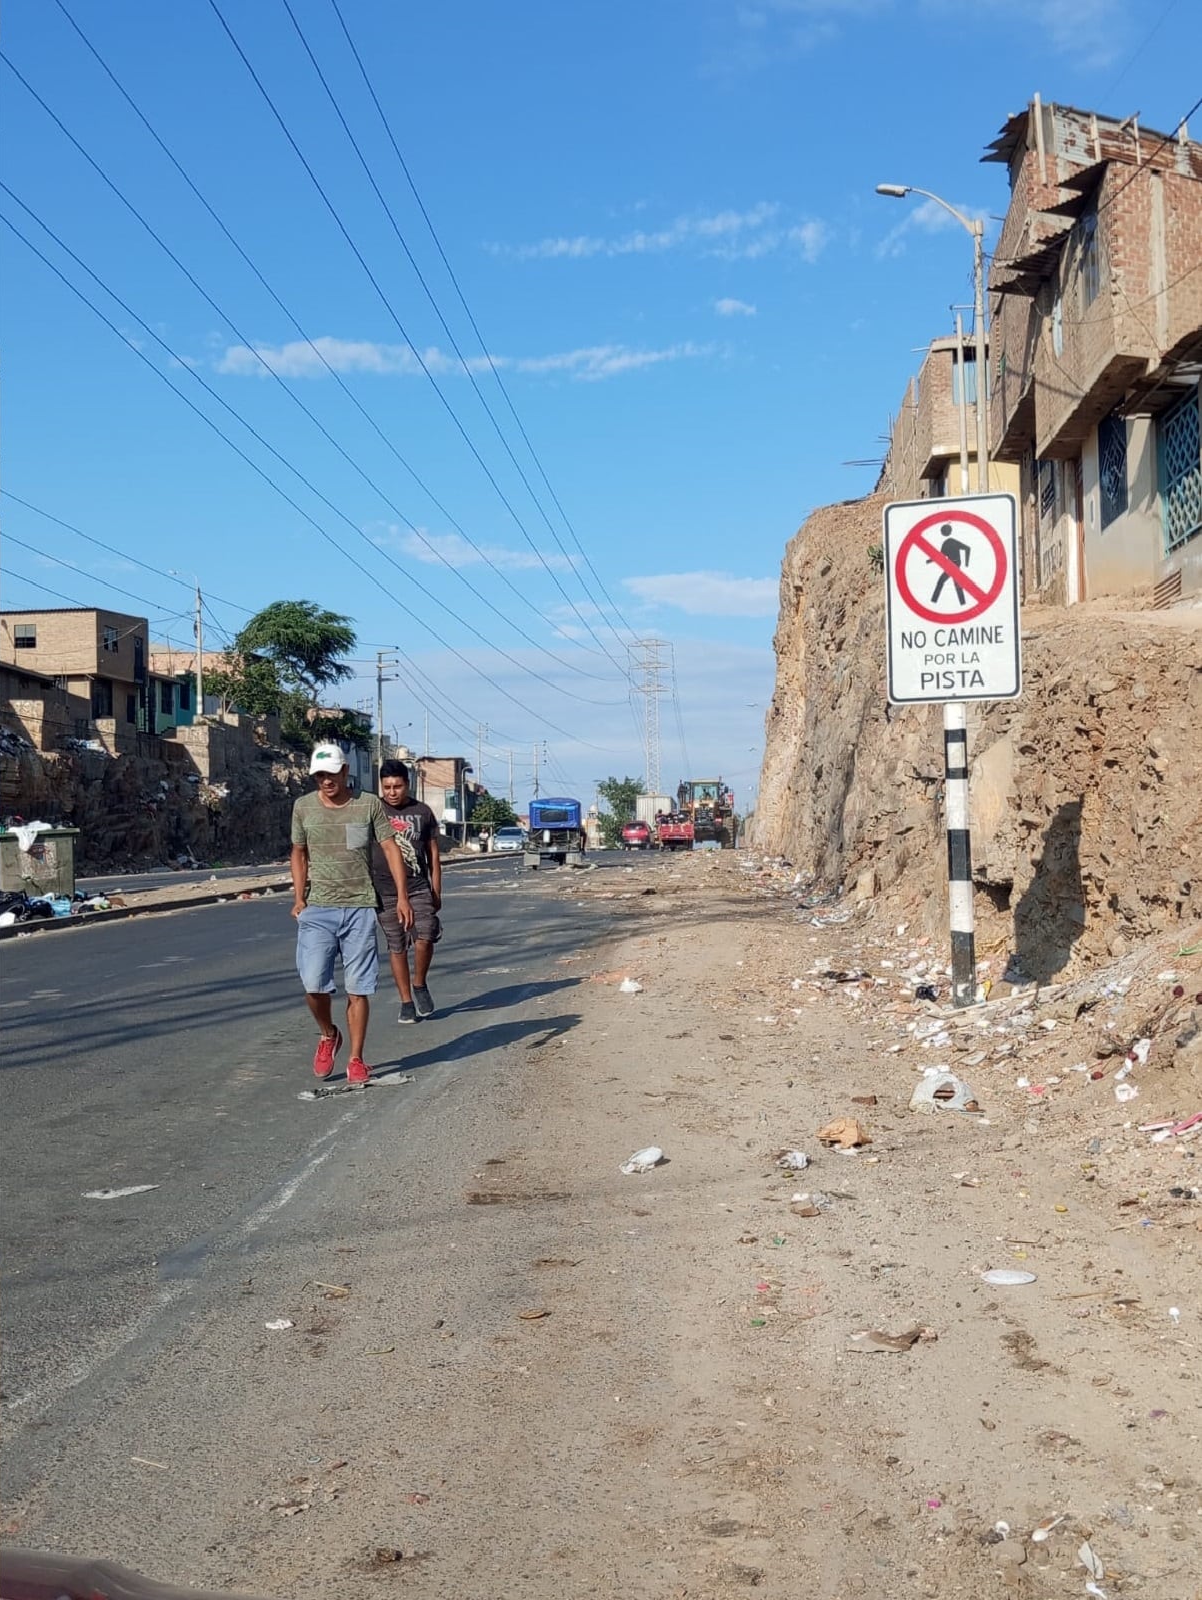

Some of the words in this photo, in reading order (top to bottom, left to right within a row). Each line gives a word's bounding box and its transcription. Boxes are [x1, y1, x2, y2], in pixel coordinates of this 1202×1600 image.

[901, 630, 926, 649] NO
[934, 625, 1004, 647] CAMINE
[924, 653, 956, 666] POR
[961, 651, 980, 664] LA
[920, 669, 985, 691] PISTA
